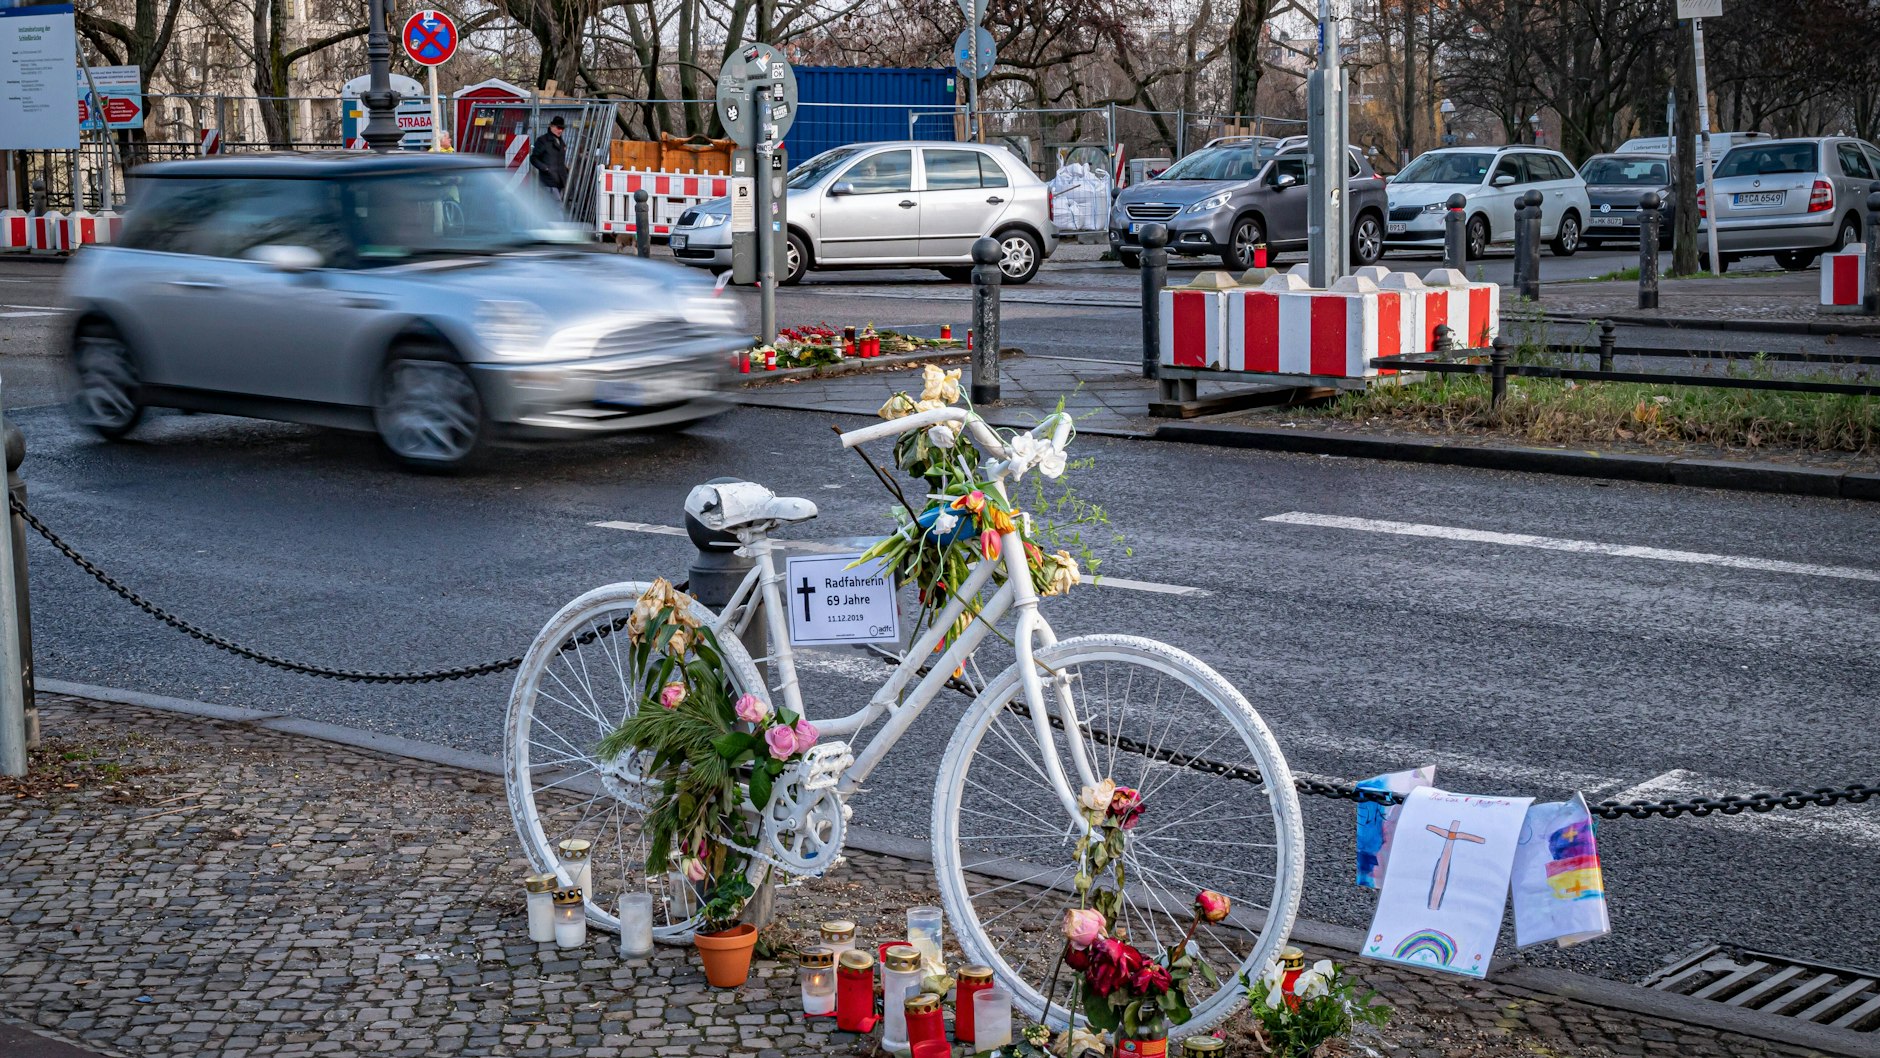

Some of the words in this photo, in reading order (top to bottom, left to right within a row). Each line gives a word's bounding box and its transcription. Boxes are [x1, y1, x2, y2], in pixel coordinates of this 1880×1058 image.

[398, 116, 432, 128] STRABA
[1749, 194, 1759, 203] CA
[1761, 194, 1781, 202] 6549
[1135, 224, 1140, 232] B
[825, 576, 884, 589] Radfahrerin
[827, 595, 840, 606] 69
[843, 594, 871, 605] Jahre
[828, 614, 864, 623] 11.12.2019
